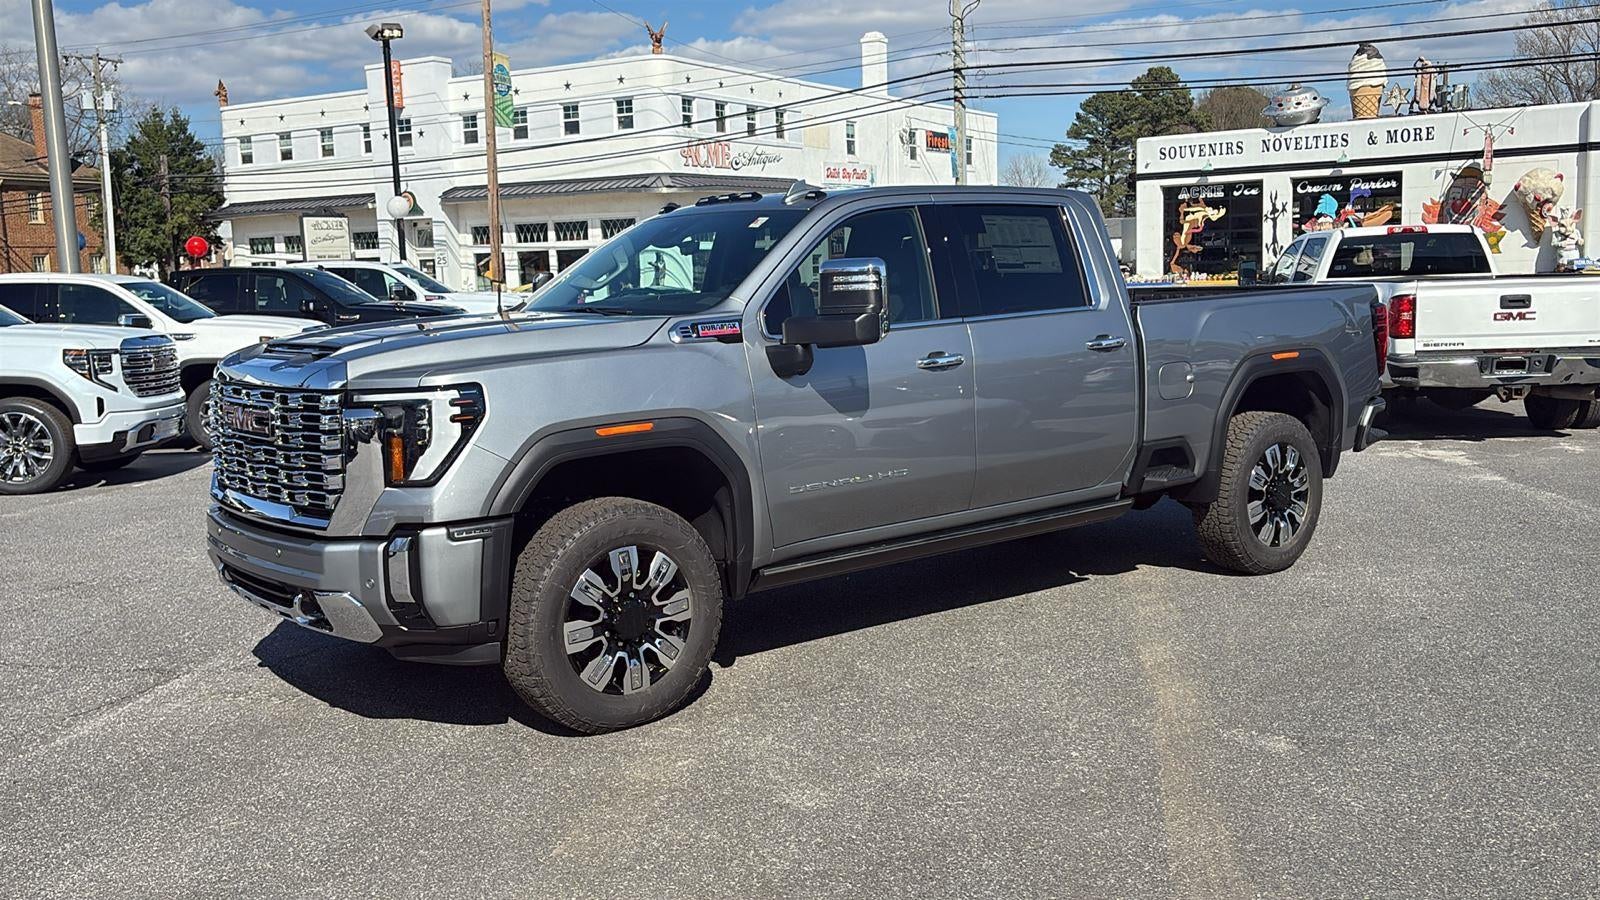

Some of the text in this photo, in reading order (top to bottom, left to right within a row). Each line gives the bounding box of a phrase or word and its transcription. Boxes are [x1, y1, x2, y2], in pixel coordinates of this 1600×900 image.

[927, 130, 949, 149] Firest
[1159, 126, 1436, 160] SOUVENIRS NOVELTIES & MORE
[680, 139, 731, 169] ACME
[1178, 178, 1400, 199] ACME Ice Cream Parlor
[437, 256, 447, 265] 25
[1493, 311, 1537, 322] GMC
[701, 322, 738, 332] DURAMAX
[222, 404, 270, 434] GMC
